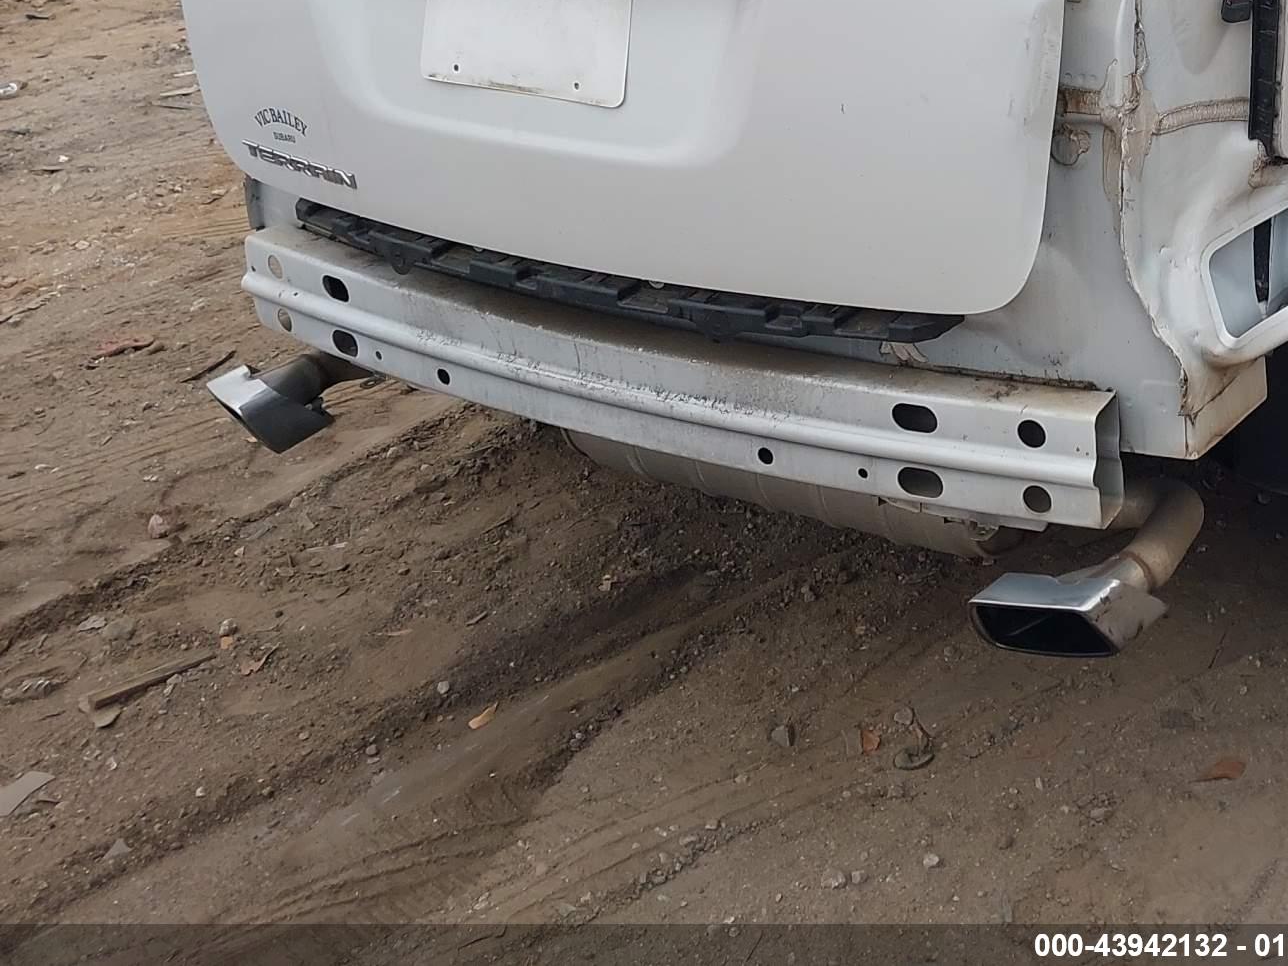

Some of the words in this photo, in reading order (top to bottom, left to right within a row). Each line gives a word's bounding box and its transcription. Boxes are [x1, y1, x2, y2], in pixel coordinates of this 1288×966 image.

[254, 108, 271, 128] VIC
[268, 107, 308, 137] BAILEY
[241, 139, 358, 190] TERRAIN
